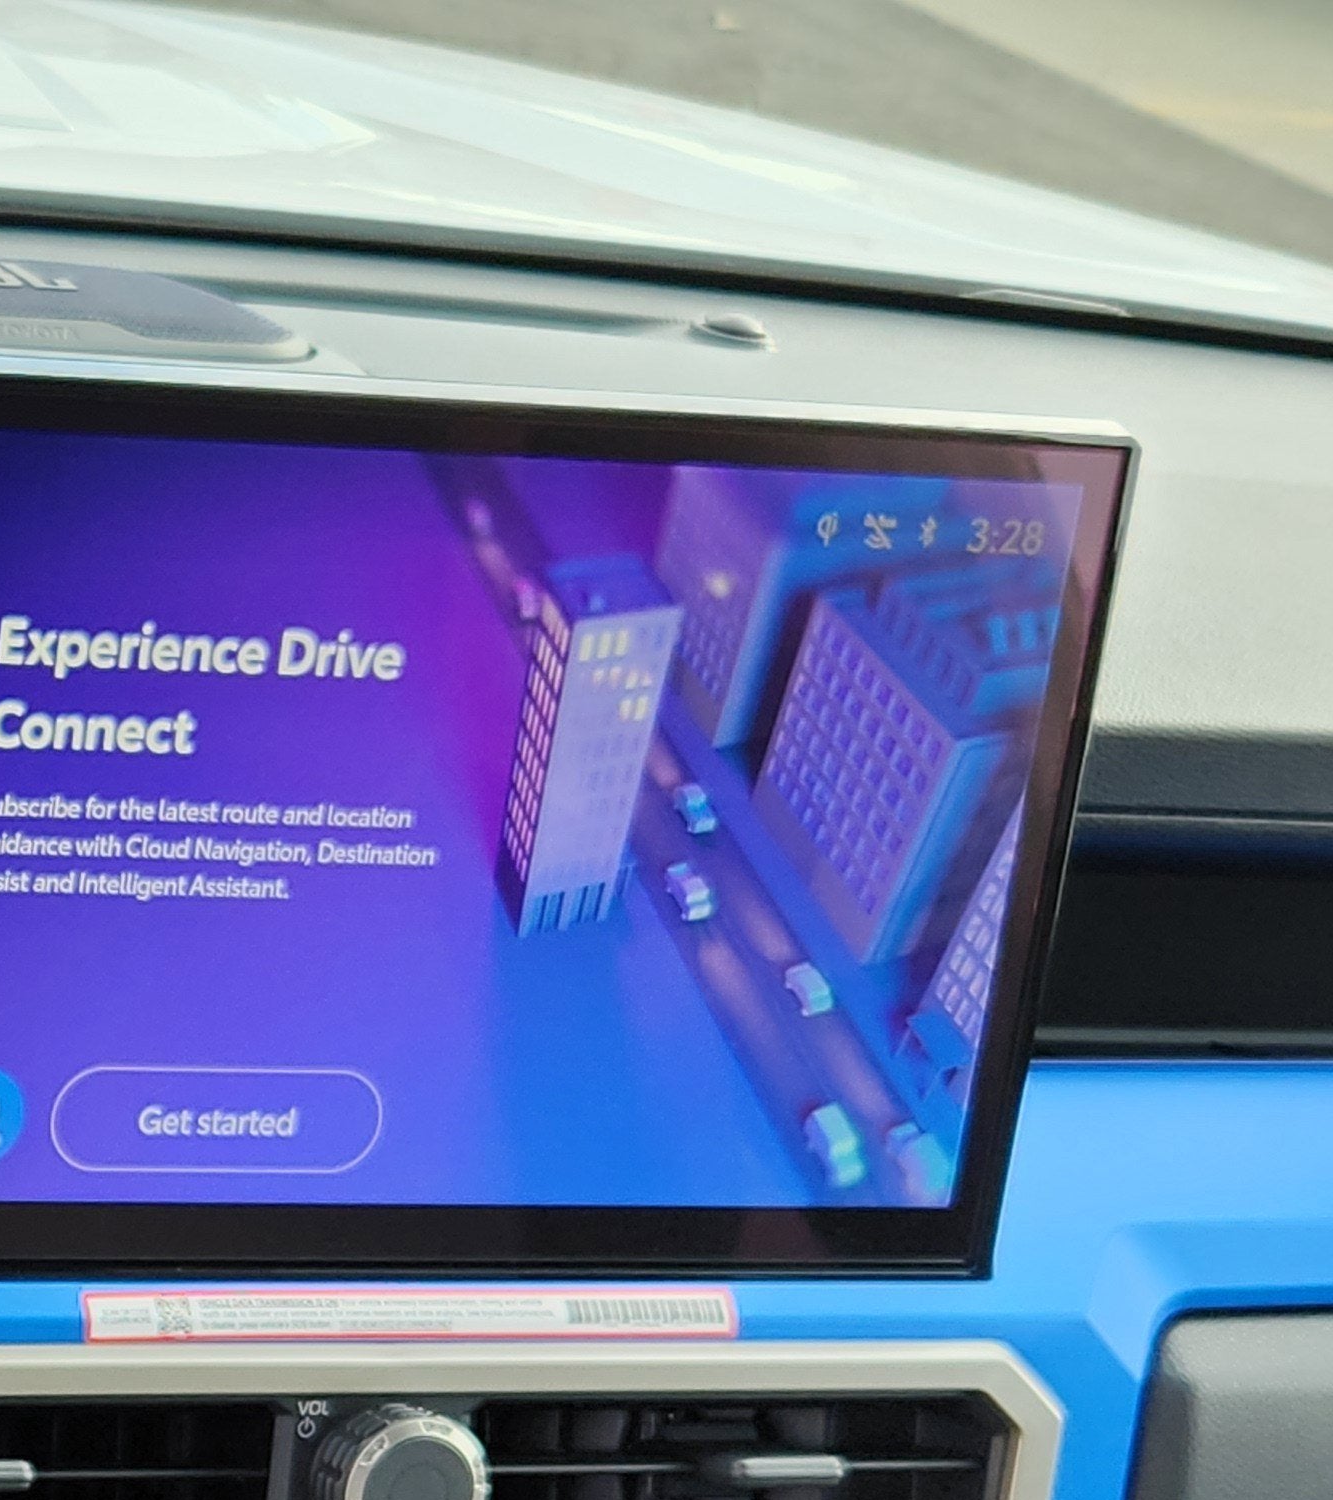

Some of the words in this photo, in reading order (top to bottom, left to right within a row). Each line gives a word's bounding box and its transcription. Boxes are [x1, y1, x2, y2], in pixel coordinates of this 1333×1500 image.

[967, 517, 1044, 555] 3:28
[277, 627, 406, 681] Drive
[85, 796, 115, 821] for
[119, 797, 155, 822] the
[158, 799, 218, 824] latest
[221, 805, 279, 826] route
[282, 804, 323, 827] and
[327, 805, 412, 830] location
[75, 834, 121, 859] with
[125, 837, 191, 861] Cloud
[194, 838, 313, 867] Navigation,
[317, 841, 437, 867] Destination
[33, 871, 75, 895] and
[78, 872, 187, 901] Intelligent
[189, 875, 290, 900] Assistant.
[138, 1106, 192, 1136] Get
[196, 1107, 299, 1138] started
[298, 1401, 329, 1416] VOL
